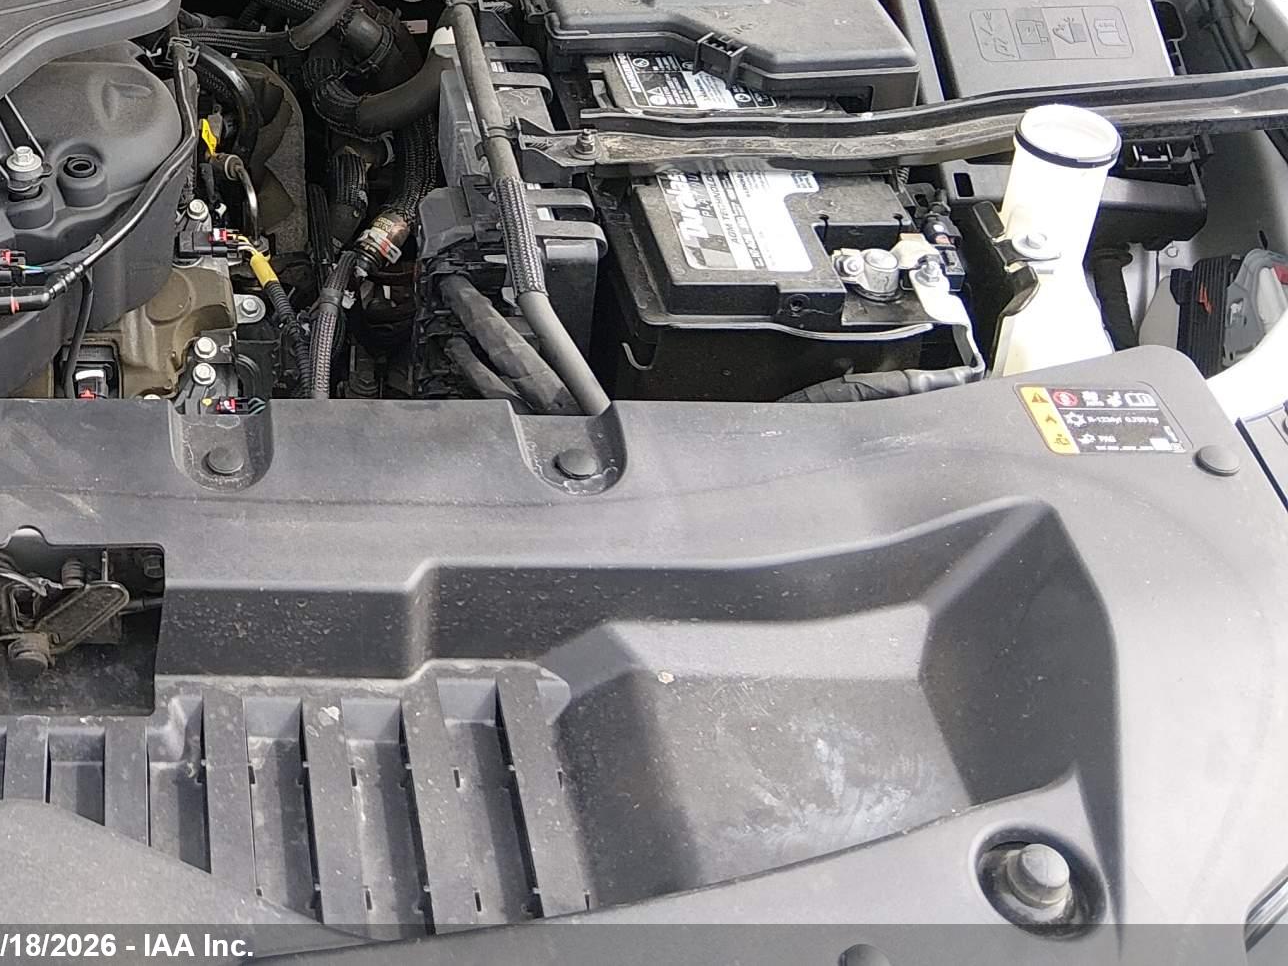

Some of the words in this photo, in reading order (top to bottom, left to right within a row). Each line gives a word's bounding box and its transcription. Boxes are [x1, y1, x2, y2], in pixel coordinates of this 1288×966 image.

[666, 173, 710, 240] Duralas
[687, 173, 713, 218] PLATINU
[726, 222, 740, 244] AGM
